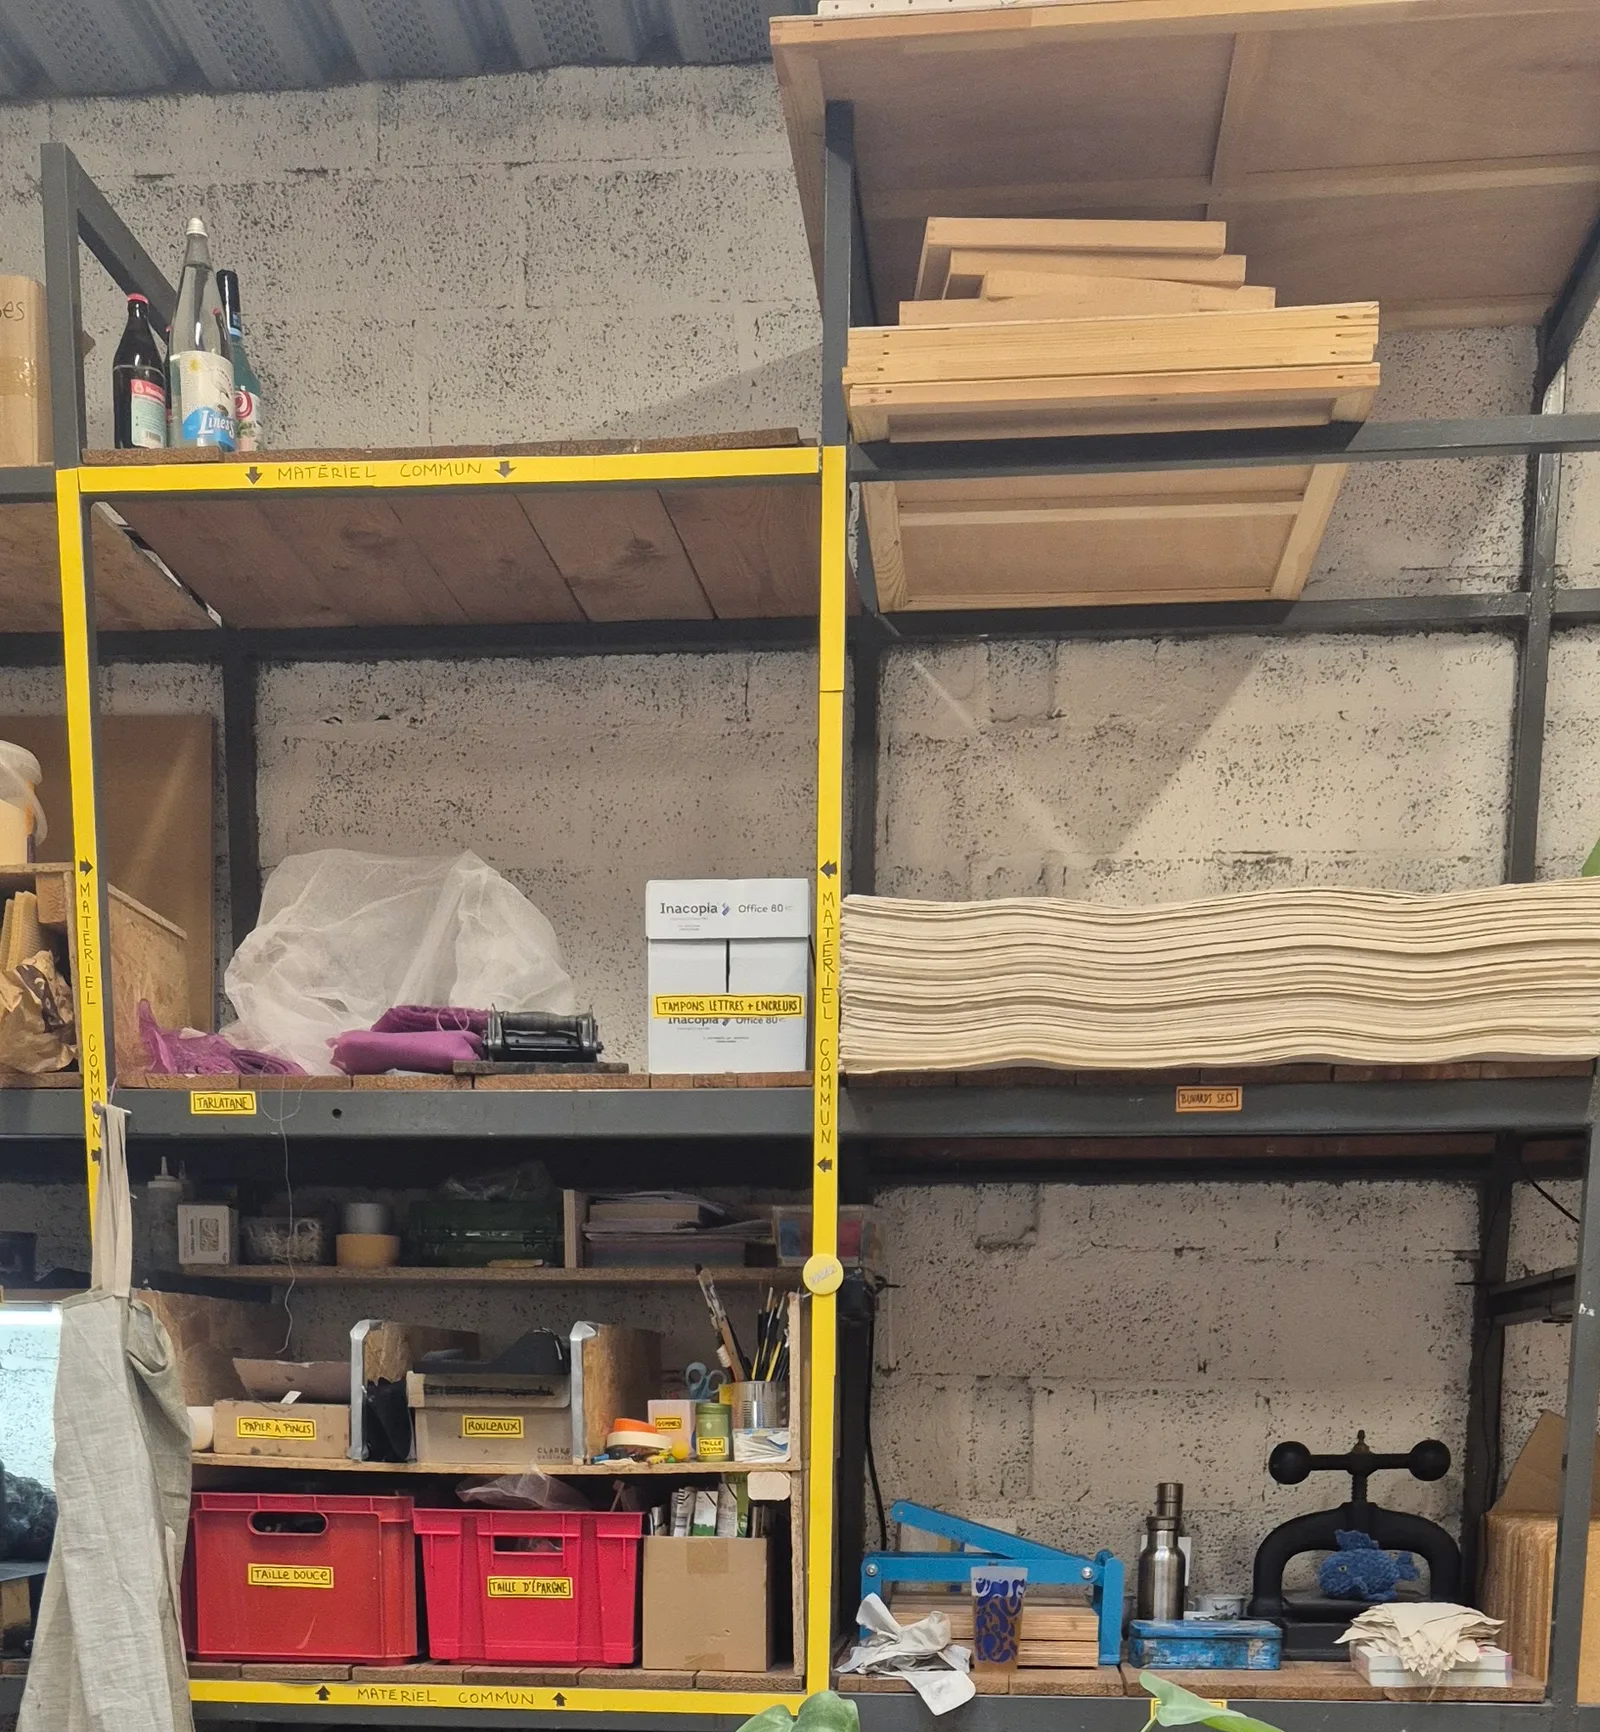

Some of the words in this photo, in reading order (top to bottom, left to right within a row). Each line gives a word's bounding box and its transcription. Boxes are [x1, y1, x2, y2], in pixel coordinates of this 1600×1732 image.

[0, 300, 24, 322] es
[399, 462, 483, 477] COMMUN
[660, 902, 718, 916] Inacopia
[738, 904, 768, 914] Office
[770, 903, 784, 914] 80
[662, 1001, 705, 1012] TAMPONS
[709, 1000, 744, 1011] LETTRES
[755, 1000, 798, 1012] ENCREURS
[819, 1038, 832, 1144] COMMUN
[197, 1097, 248, 1110] TARLATANE
[243, 1421, 272, 1432] PAPIER
[468, 1421, 519, 1432] ROULEAUX
[490, 1581, 517, 1592] TAILLE
[458, 1691, 535, 1705] COMMUN
